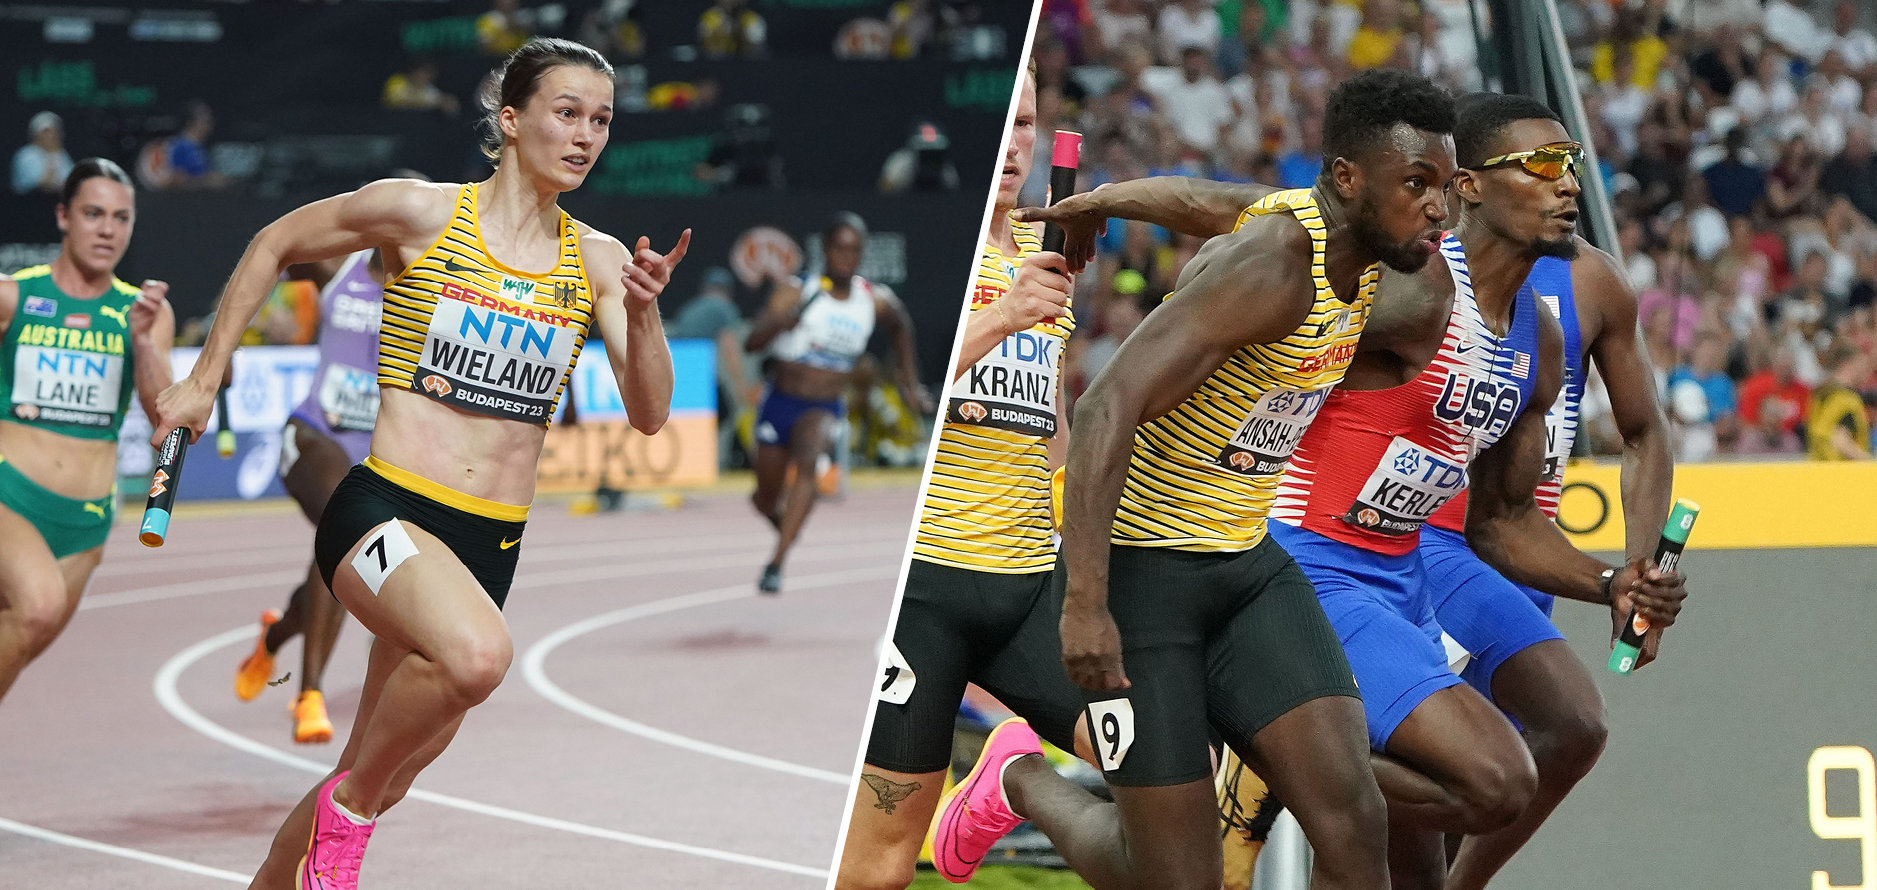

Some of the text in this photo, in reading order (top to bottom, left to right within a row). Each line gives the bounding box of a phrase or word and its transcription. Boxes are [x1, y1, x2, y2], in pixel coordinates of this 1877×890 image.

[17, 323, 125, 356] AUSTRALIA
[459, 305, 557, 360] NTN
[1001, 332, 1053, 368] TDK
[37, 351, 108, 379] NTN
[430, 337, 557, 395] WIELAND
[36, 379, 99, 407] LANE
[455, 388, 530, 416] BUDAPEST
[969, 365, 1051, 407] KRANZ
[1433, 369, 1521, 437] USA
[991, 408, 1047, 430] BUDAPEST
[1370, 477, 1452, 517] KERLE
[1680, 513, 1694, 530] 8
[364, 534, 388, 574] 7
[1618, 656, 1634, 673] 8
[1101, 711, 1121, 760] 9
[1807, 745, 1877, 890] 9
